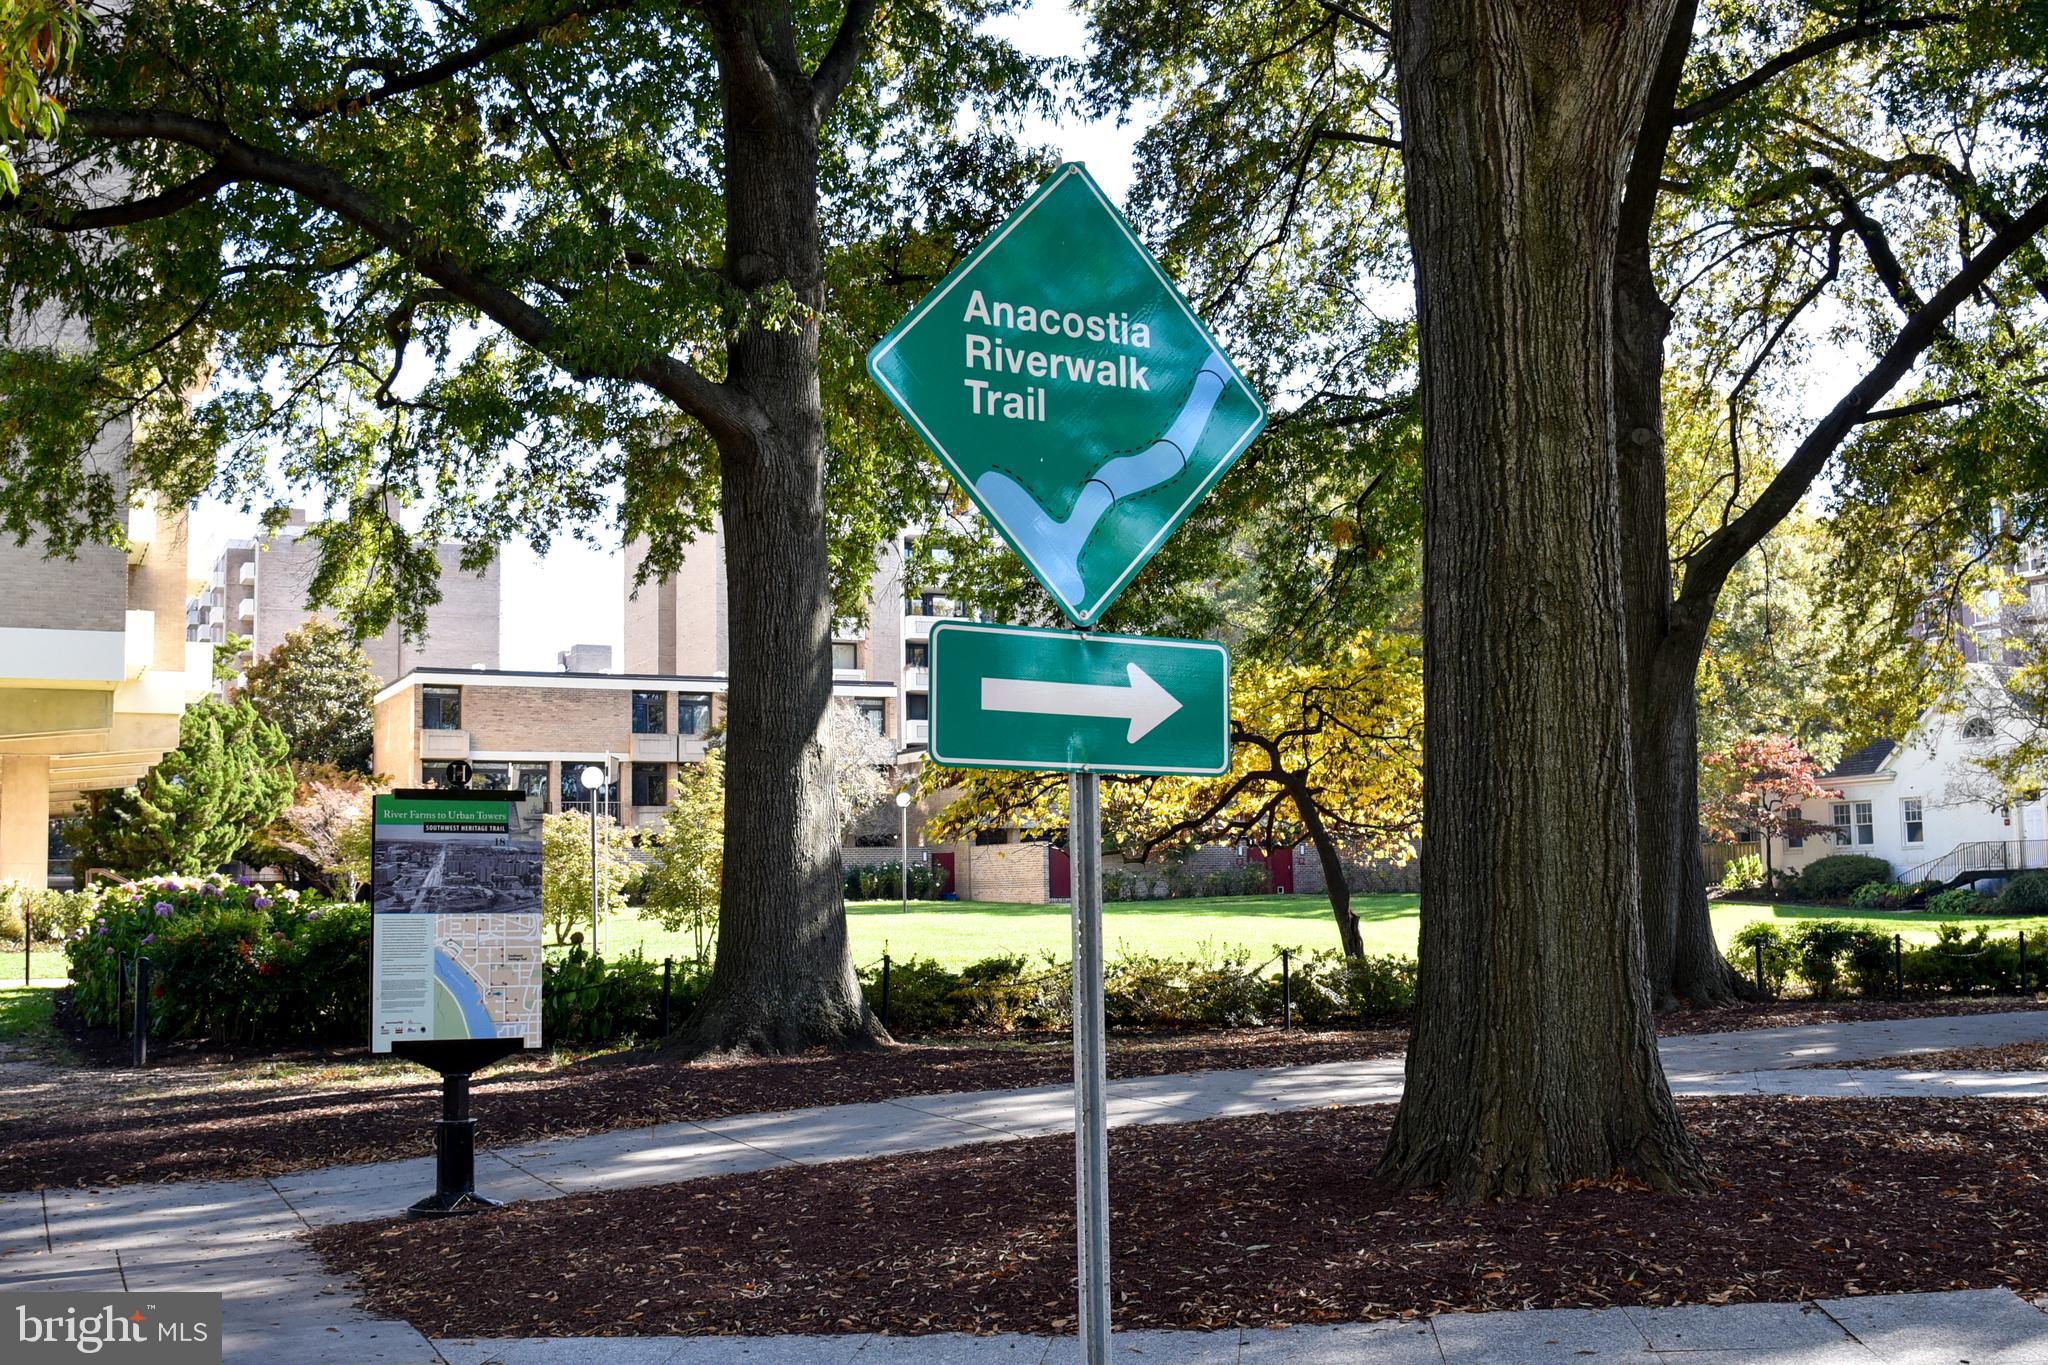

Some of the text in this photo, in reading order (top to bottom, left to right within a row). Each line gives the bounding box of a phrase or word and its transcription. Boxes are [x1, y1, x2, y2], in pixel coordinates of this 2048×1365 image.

[963, 290, 1151, 348] Anacostia
[966, 334, 1151, 391] Riverwalk
[964, 379, 1045, 422] Trail
[383, 809, 408, 819] River
[410, 809, 436, 819] Farms
[448, 810, 475, 820] Urban
[476, 810, 506, 820] Towers
[495, 837, 506, 846] 18
